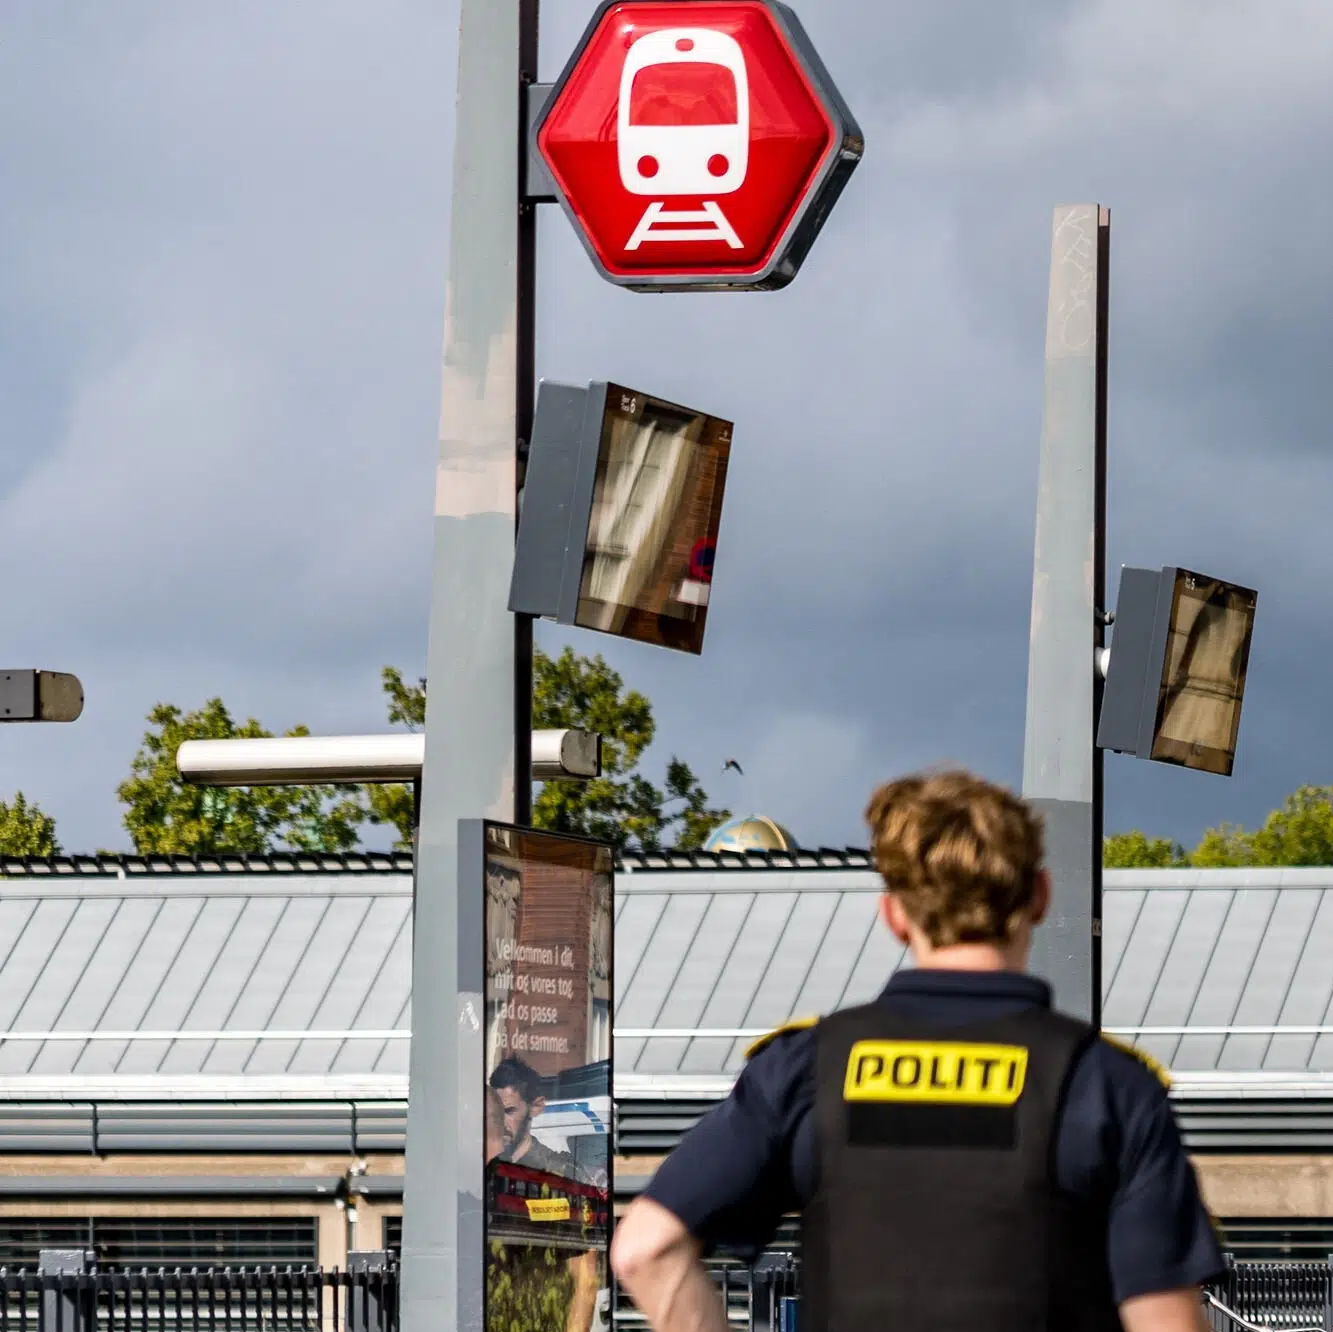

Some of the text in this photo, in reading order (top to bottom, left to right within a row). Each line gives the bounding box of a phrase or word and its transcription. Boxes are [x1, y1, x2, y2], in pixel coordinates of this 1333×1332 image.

[495, 938, 553, 965] Velkommen
[555, 945, 559, 966] i
[494, 968, 514, 990] mit
[516, 974, 529, 995] og
[531, 976, 557, 995] vores
[495, 998, 558, 1027] Lad os passe
[511, 1027, 528, 1050] det
[854, 1055, 1017, 1092] POLITI
